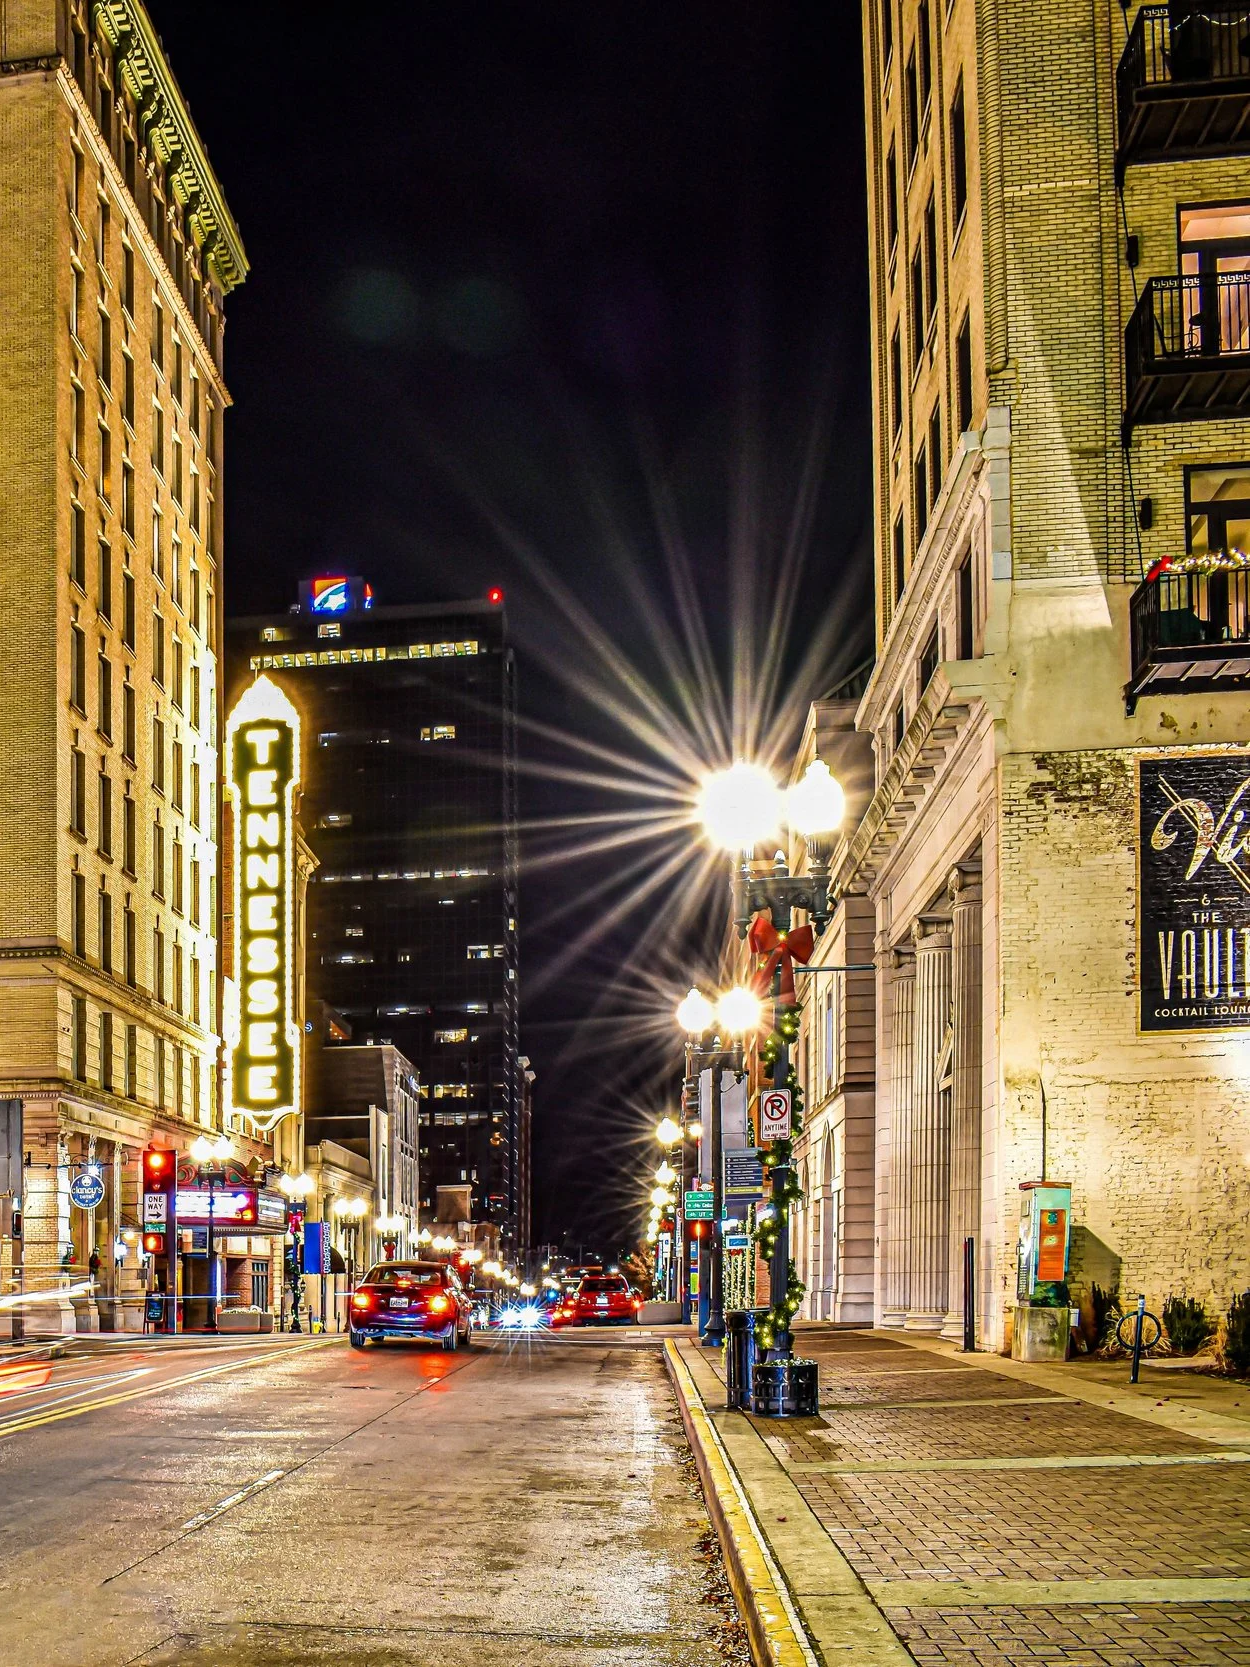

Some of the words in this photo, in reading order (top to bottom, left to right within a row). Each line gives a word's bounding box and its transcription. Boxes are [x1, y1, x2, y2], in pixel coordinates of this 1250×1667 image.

[245, 729, 281, 1101] TENNESSEE
[1192, 911, 1221, 924] THE
[1154, 1006, 1210, 1018] COCKTAIL
[764, 1123, 787, 1131] ANYTIME
[71, 1186, 103, 1196] clancy's
